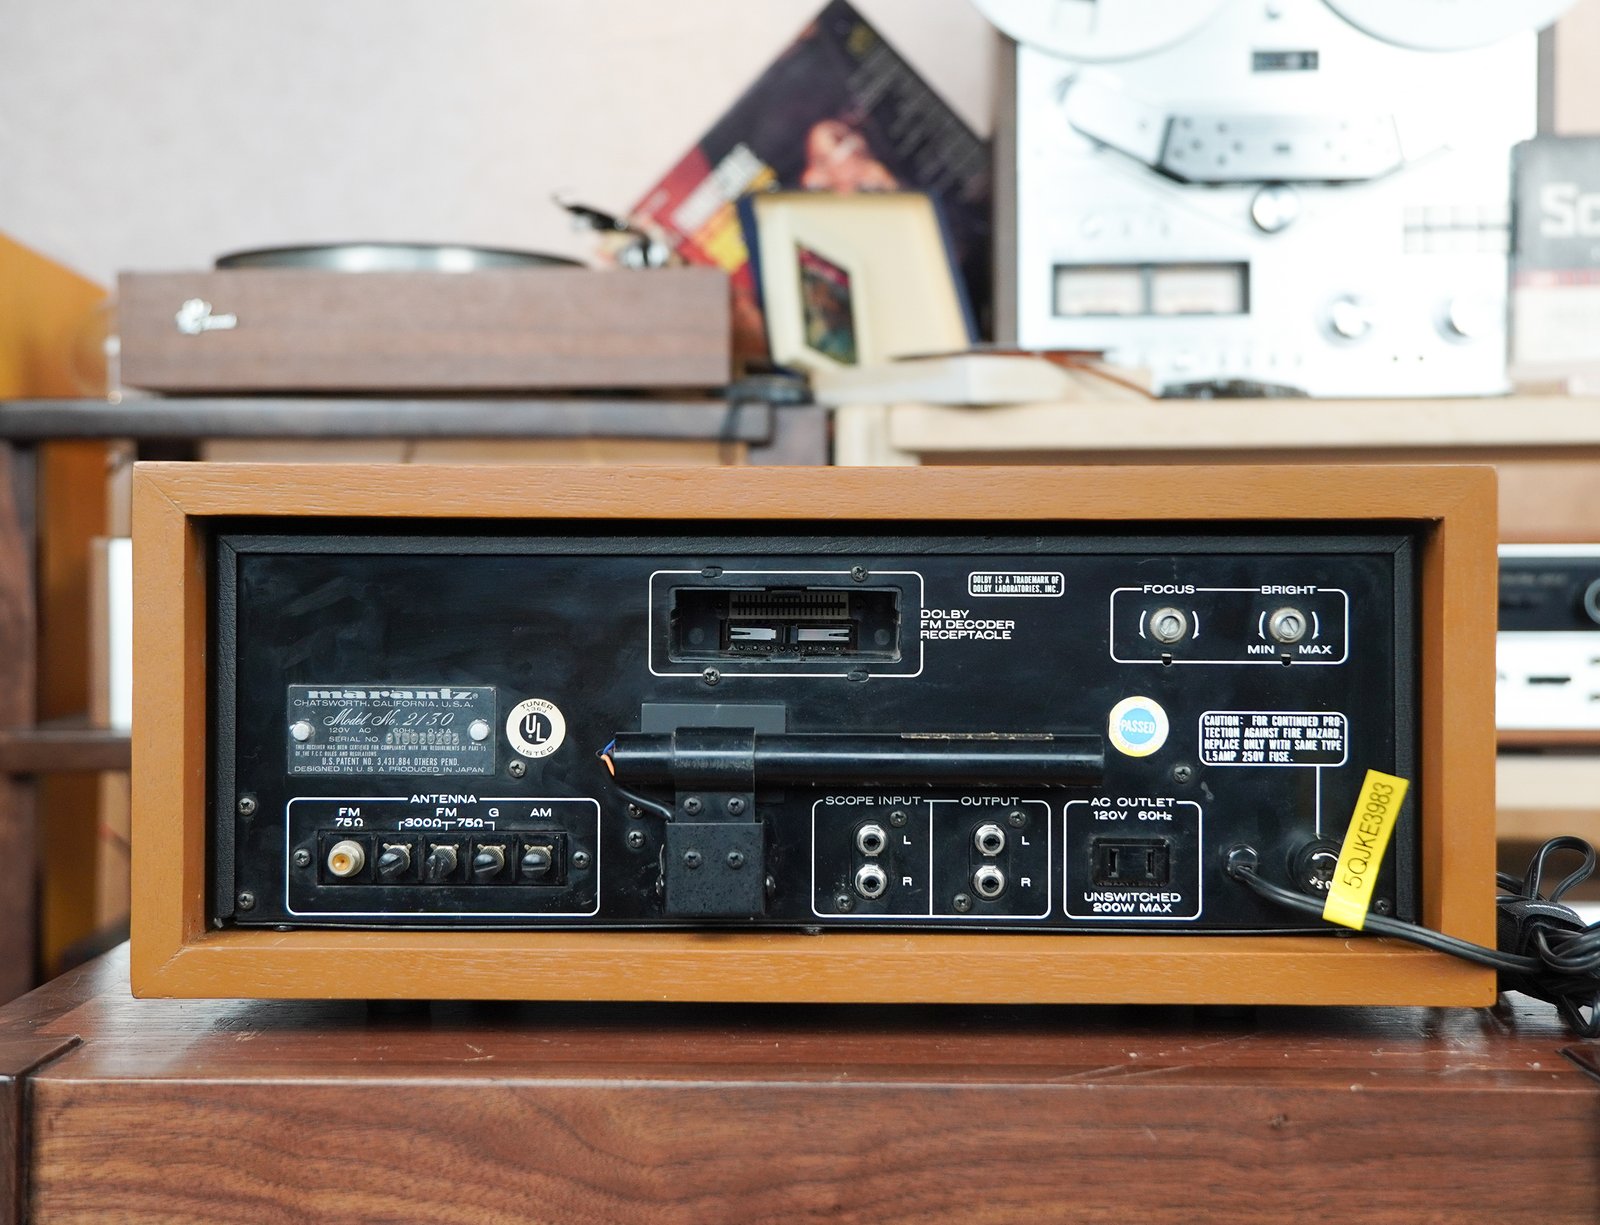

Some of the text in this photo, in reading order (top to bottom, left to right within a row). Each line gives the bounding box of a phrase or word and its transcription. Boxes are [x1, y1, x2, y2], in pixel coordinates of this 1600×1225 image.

[972, 575, 1060, 584] DOLBY IS A TRADEMARK OF
[972, 584, 992, 593] DOLBY
[1044, 584, 1059, 593] INC.
[1143, 584, 1195, 594] FOCUS
[1261, 585, 1316, 595] BRIGHT
[920, 609, 970, 619] DOLBY
[920, 620, 1015, 630] FM DECODER
[920, 630, 1012, 640] RECEPTACLE
[1247, 645, 1275, 654] MIN
[1298, 645, 1332, 655] MAX
[307, 688, 473, 700] marantz
[520, 701, 554, 710] TUNER
[323, 708, 455, 727] Model No. 2130
[1204, 715, 1344, 727] CAUTION: FOR CONTINUED PRO-
[525, 714, 547, 742] UL
[1120, 719, 1156, 735] PASSED
[1204, 727, 1240, 738] TECTION
[1244, 727, 1279, 738] AGAINST
[1283, 728, 1302, 739] FIRE
[1204, 739, 1342, 751] REPLACE ONLY WITH SAME TYPE
[516, 745, 554, 757] LISTED
[362, 757, 374, 766] NO.
[414, 757, 438, 766] OTHERS
[440, 757, 460, 766] PEND.
[1242, 751, 1264, 762] 250V
[1269, 751, 1294, 762] FUSE.
[410, 794, 477, 804] ANTENNA
[825, 796, 921, 806] SCOPE INPUT
[960, 797, 1020, 806] OUTPUT
[1090, 797, 1176, 807] AC OUTLET
[338, 807, 361, 817] FM
[436, 807, 457, 817] FM
[488, 807, 499, 817] G
[530, 807, 552, 817] AM
[1093, 811, 1173, 821] 120V 60Hz
[335, 817, 364, 827] 75Ω
[404, 818, 442, 828] 300Ω
[457, 818, 484, 828] 75Ω
[903, 835, 912, 845] L
[1343, 782, 1394, 889] 5QJKE3983
[1021, 836, 1030, 846] L
[902, 876, 913, 886] R
[1020, 877, 1031, 887] R
[1309, 876, 1332, 890] USE
[1083, 892, 1182, 903] UNSWITCHED
[1092, 903, 1172, 913] 200W MAX
